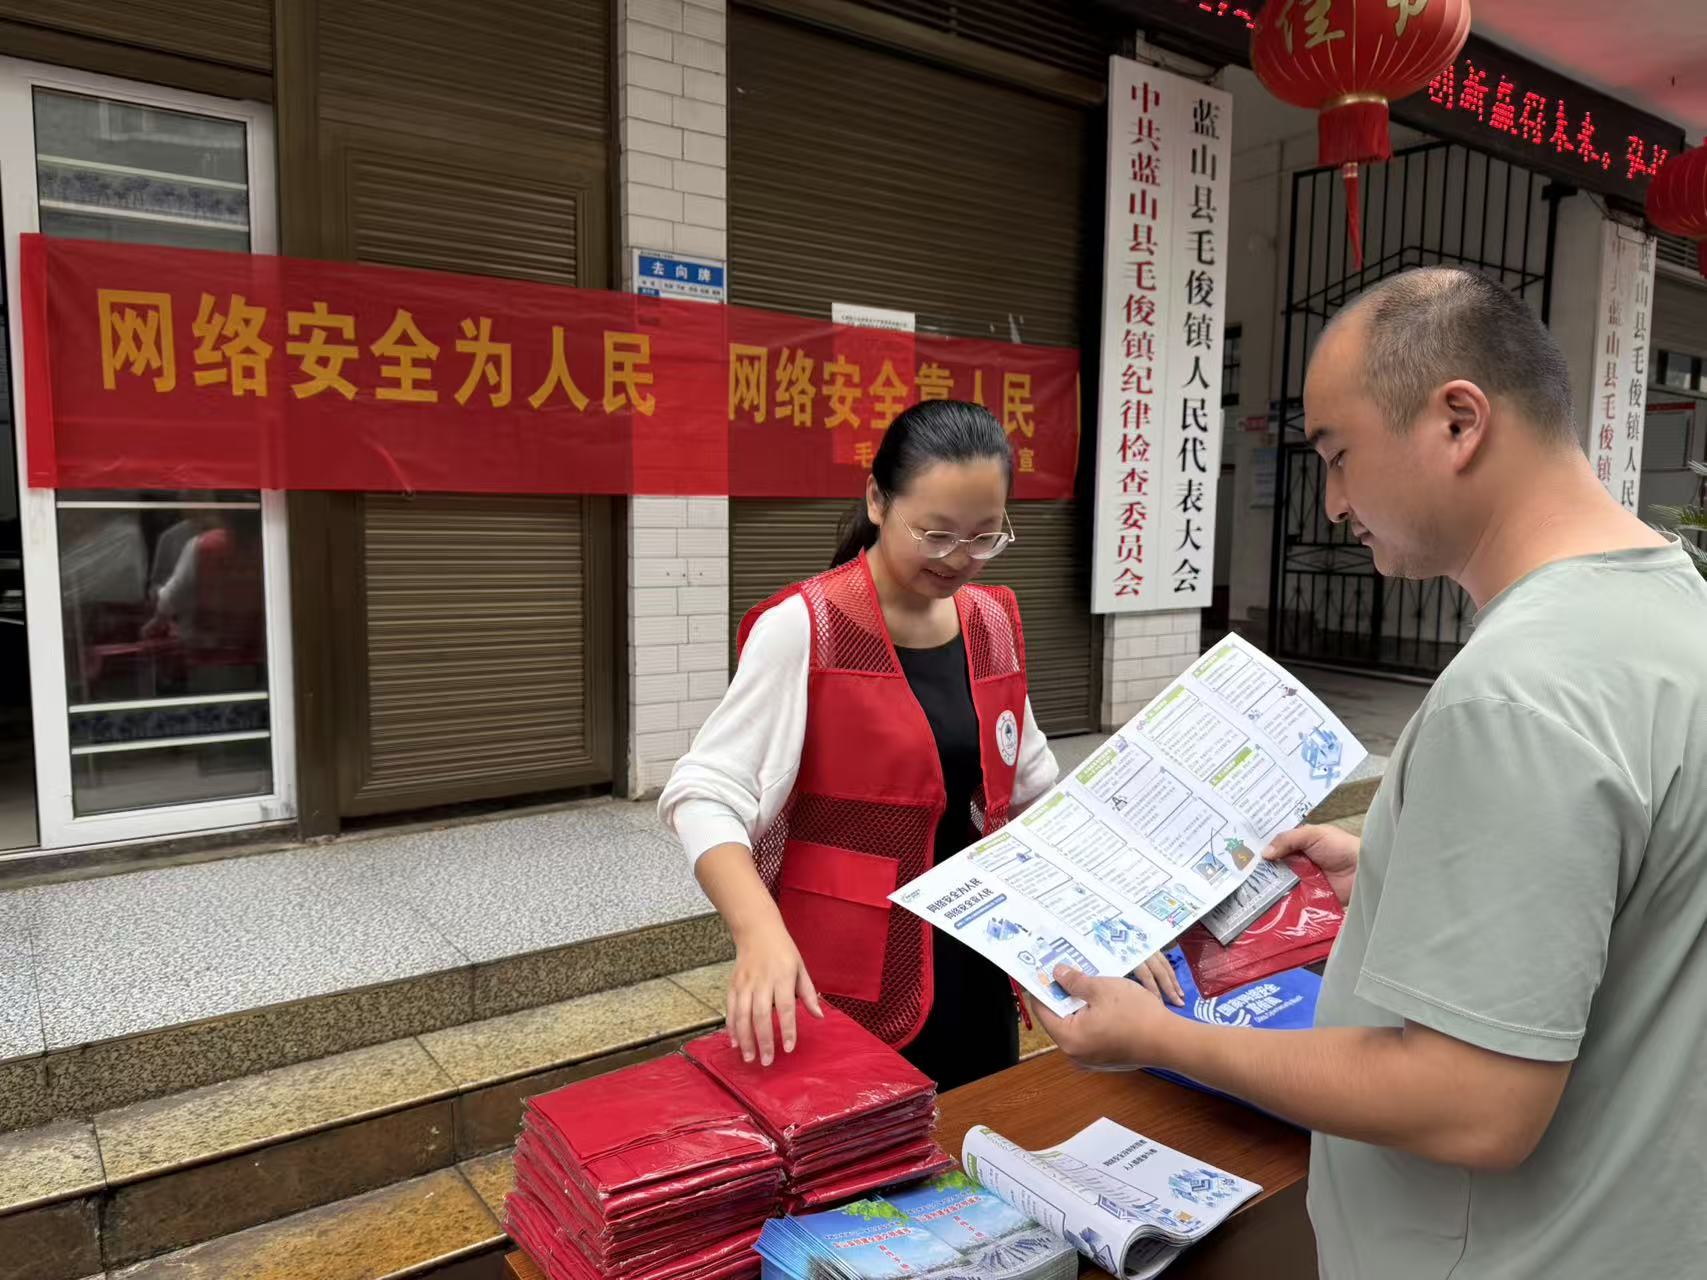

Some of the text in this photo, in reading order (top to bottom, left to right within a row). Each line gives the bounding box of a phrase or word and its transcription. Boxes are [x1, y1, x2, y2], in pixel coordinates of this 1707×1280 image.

[97, 288, 656, 416] 网络安全为人民
[1114, 82, 1161, 597] 中共蓝山县毛俊镇纪律检查委员会
[1172, 98, 1221, 593] 蓝山县毛俊镇人民代表大会
